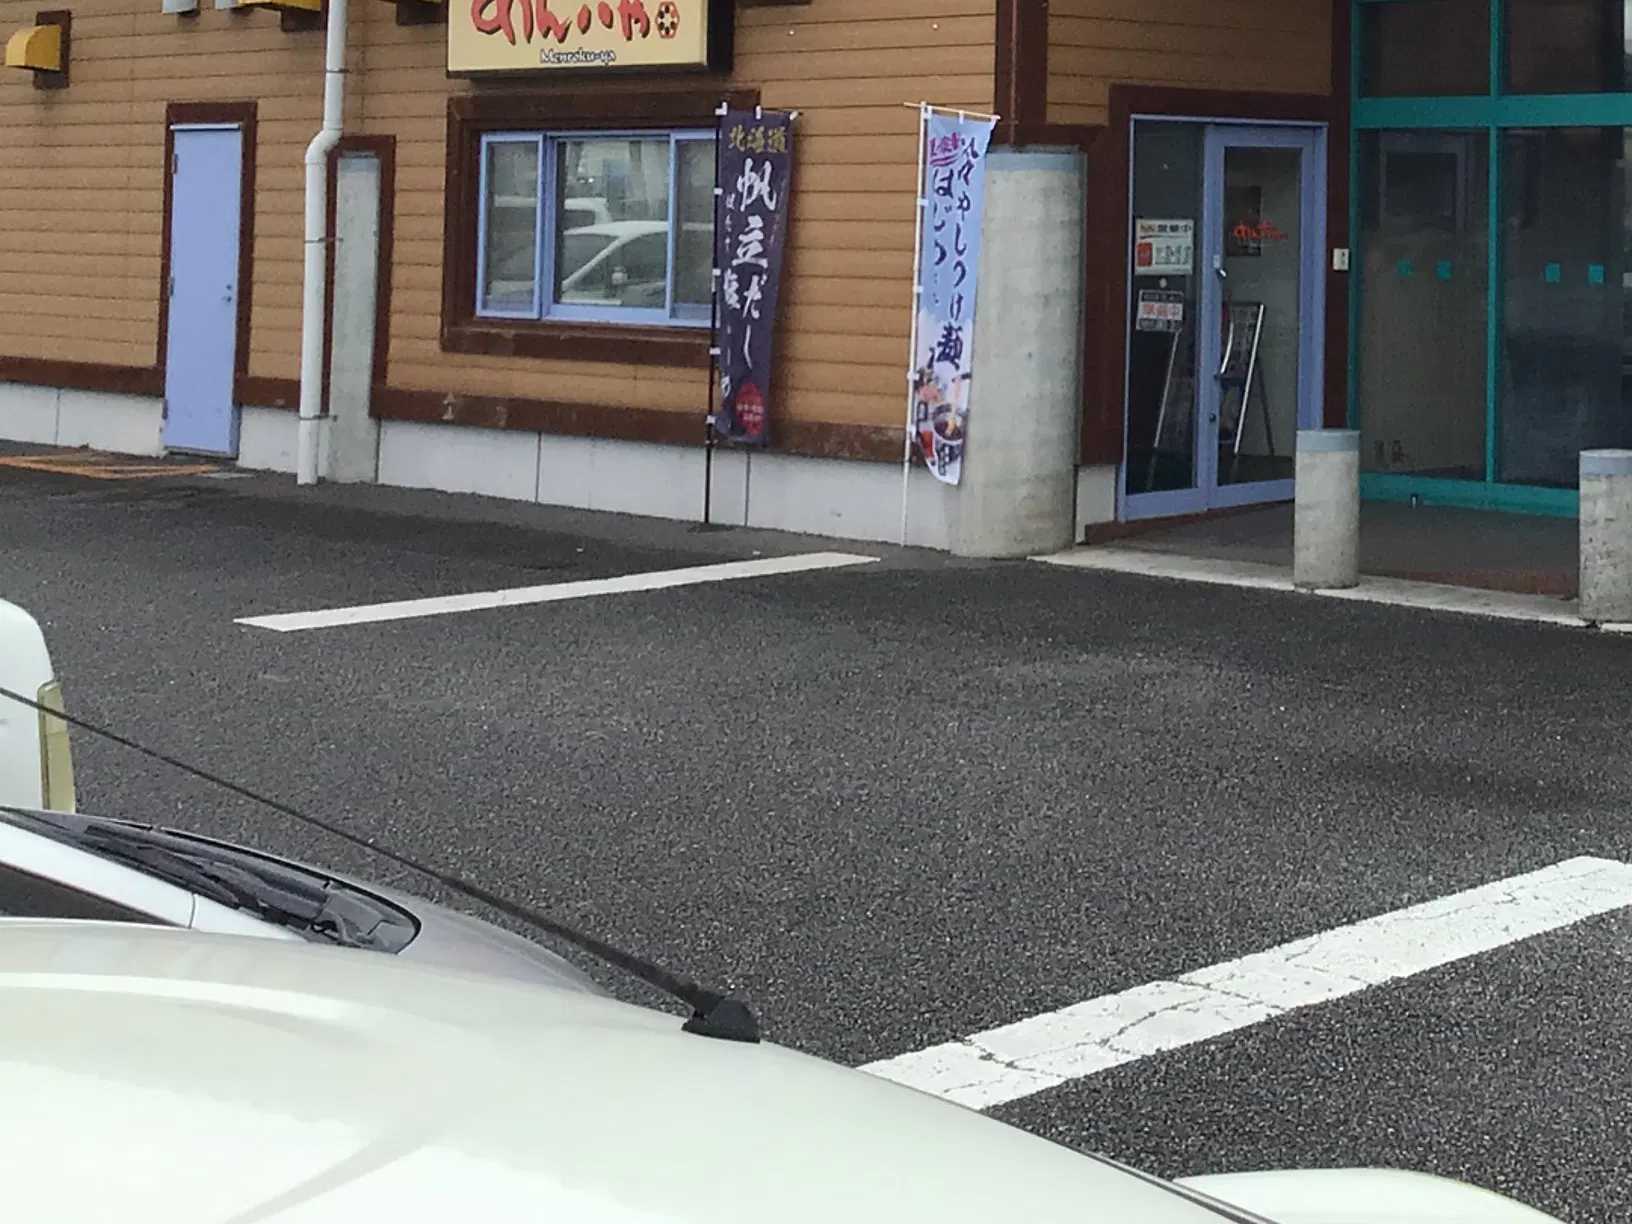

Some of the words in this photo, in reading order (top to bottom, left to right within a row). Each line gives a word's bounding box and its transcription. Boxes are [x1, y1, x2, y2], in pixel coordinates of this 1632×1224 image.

[728, 124, 787, 153] 北海道
[731, 157, 778, 370] 帆立だし
